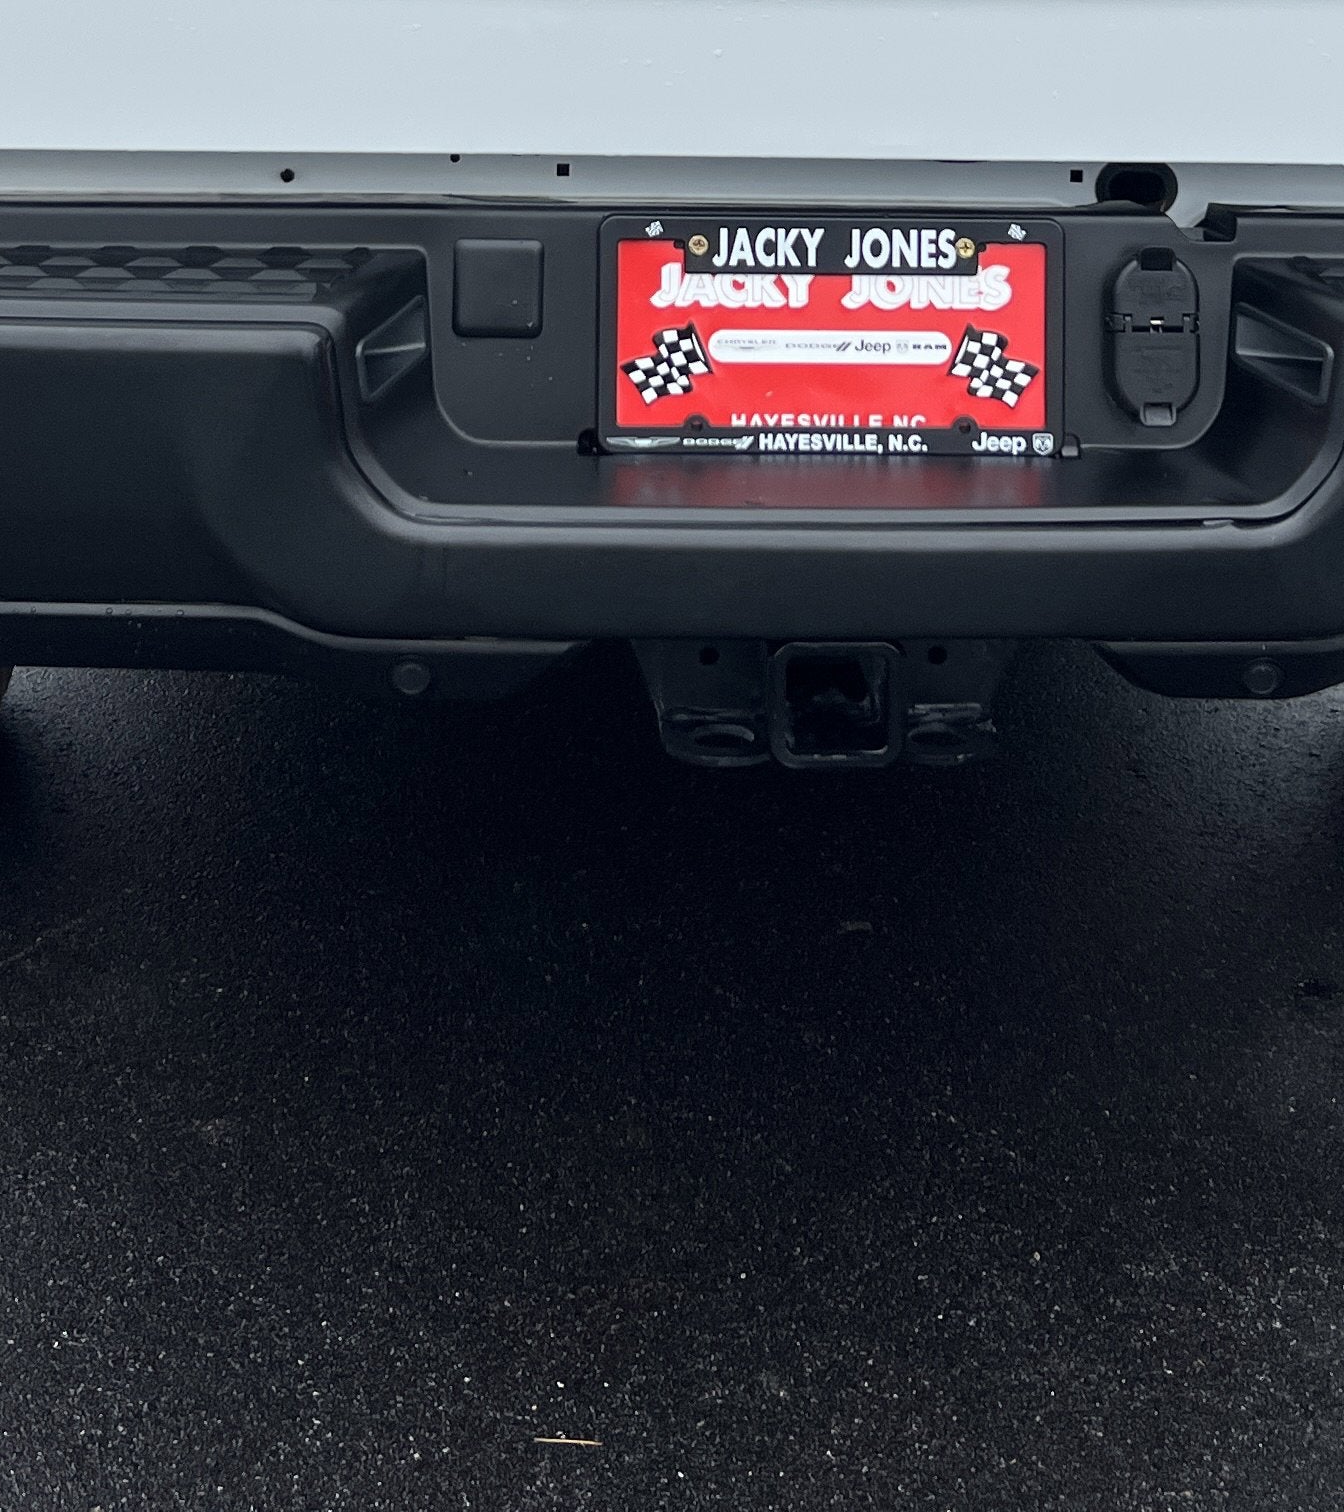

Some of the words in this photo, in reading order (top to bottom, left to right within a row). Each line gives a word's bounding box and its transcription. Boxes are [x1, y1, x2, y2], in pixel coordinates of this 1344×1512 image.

[712, 228, 825, 268] JACKY
[844, 228, 957, 269] JONES
[650, 262, 815, 310] JACKY
[840, 265, 1012, 312] JONES
[854, 339, 891, 354] Jeep
[759, 433, 884, 454] HAYESVILLE,
[888, 434, 928, 452] N.C.
[971, 431, 1027, 455] Jeep
